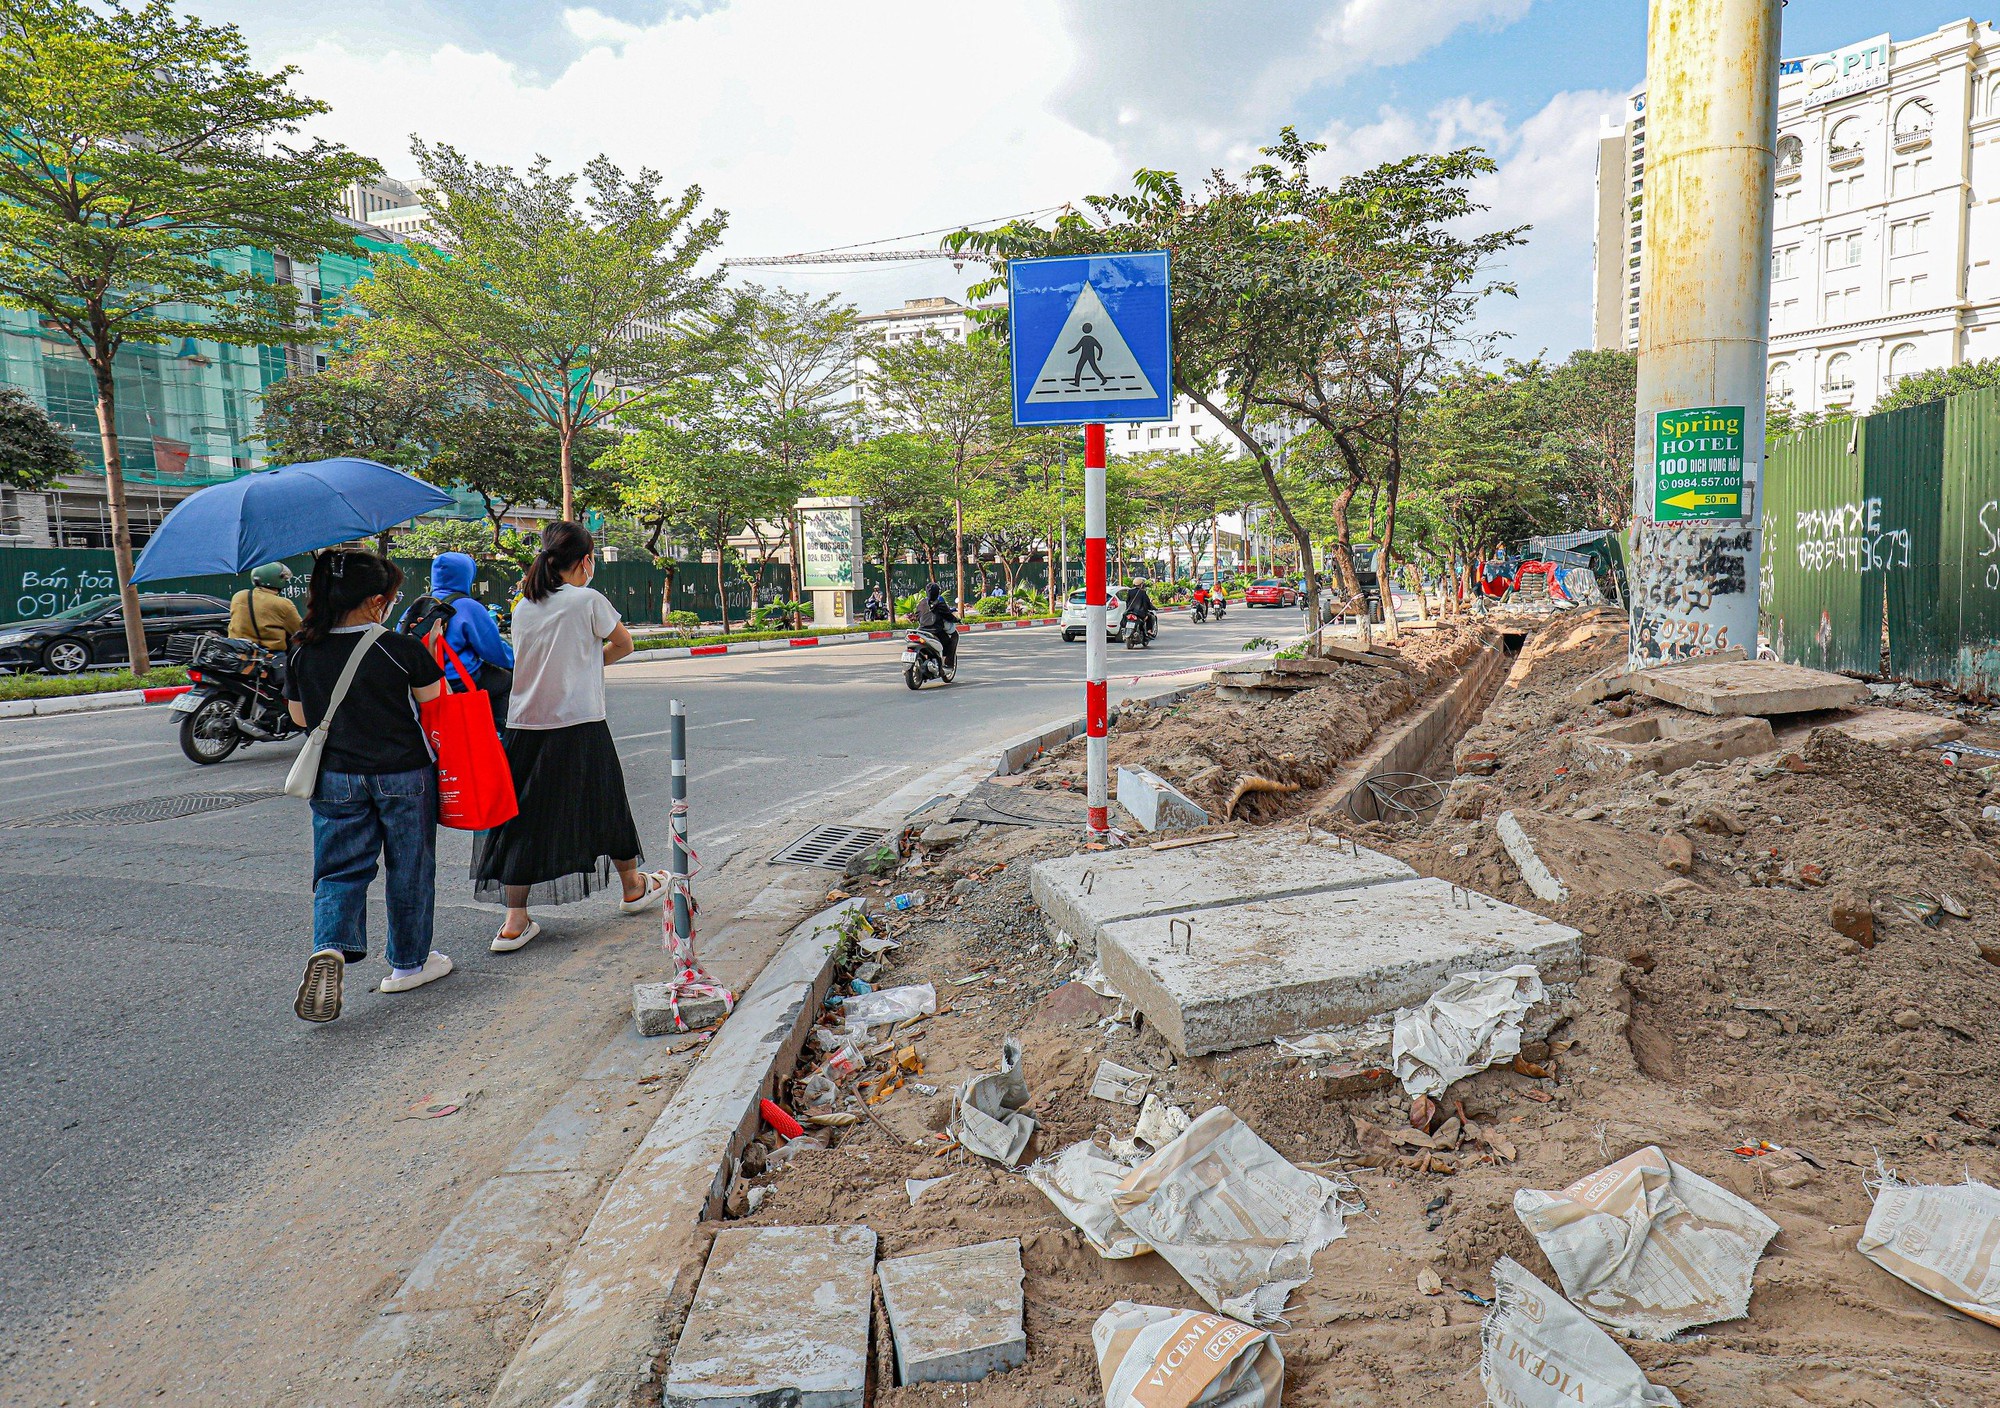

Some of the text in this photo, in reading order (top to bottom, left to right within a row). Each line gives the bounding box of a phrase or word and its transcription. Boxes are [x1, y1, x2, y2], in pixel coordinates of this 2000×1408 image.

[1843, 44, 1886, 77] PTI
[1661, 415, 1738, 438] Spring
[1662, 437, 1738, 455] HOTEL
[1659, 457, 1687, 475] 100
[1690, 458, 1706, 475] DỊCH
[1671, 477, 1740, 489] 0984.557.001
[1704, 495, 1717, 503] 50
[1798, 528, 1912, 576] 0385449679
[22, 567, 68, 591] Bán
[1588, 1173, 1619, 1199] PCB30
[1149, 1323, 1207, 1387] VICEM
[1508, 1340, 1584, 1403] VICEM
